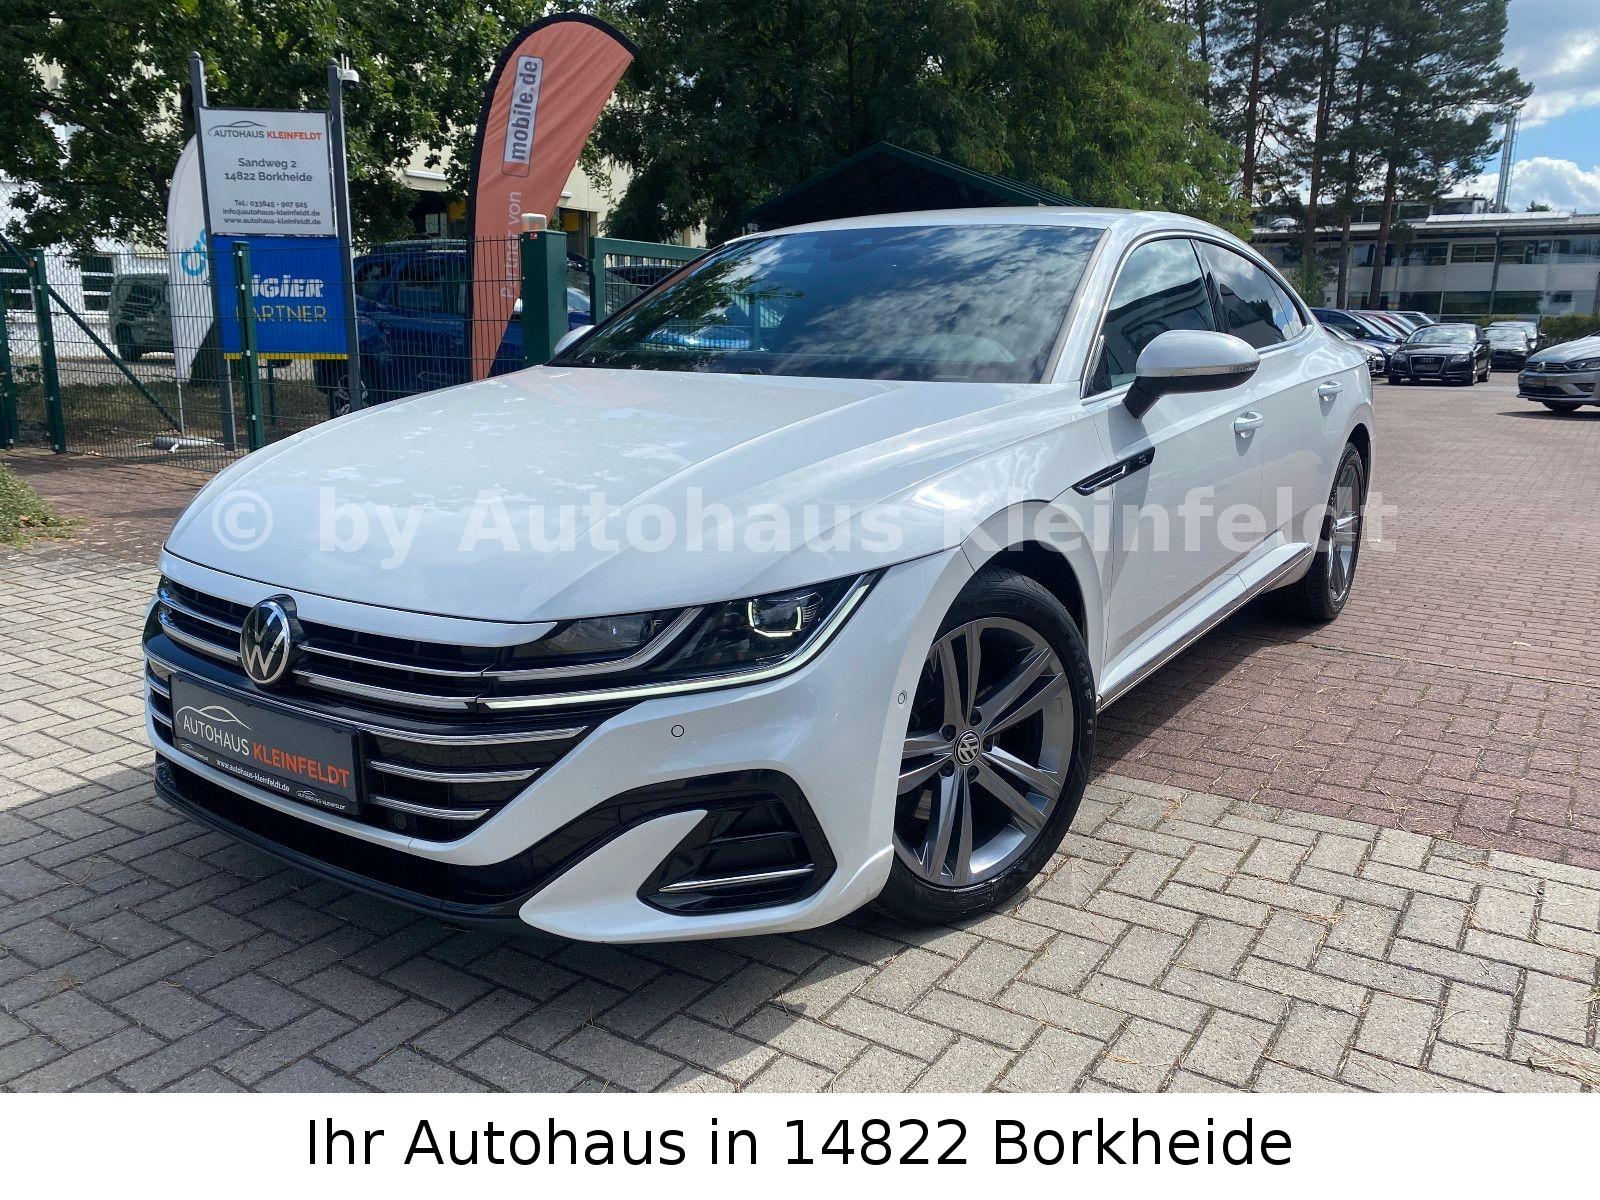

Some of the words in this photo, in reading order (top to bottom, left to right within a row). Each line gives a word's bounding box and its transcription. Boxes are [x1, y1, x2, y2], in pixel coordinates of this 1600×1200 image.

[511, 60, 539, 161] mobile.de
[213, 129, 265, 139] AUTOHAUS
[266, 130, 322, 141] KLEINFELDT
[238, 157, 289, 170] Sandweg
[290, 160, 297, 169] 2
[224, 171, 256, 182] 14822
[258, 172, 313, 183] Borkheide
[508, 190, 522, 225] von
[223, 217, 322, 226] www.autohaus-kleinfeldt.de
[501, 229, 520, 298] Partner
[183, 715, 250, 756] AUTOHAUS
[253, 742, 349, 788] KLEINFELDT
